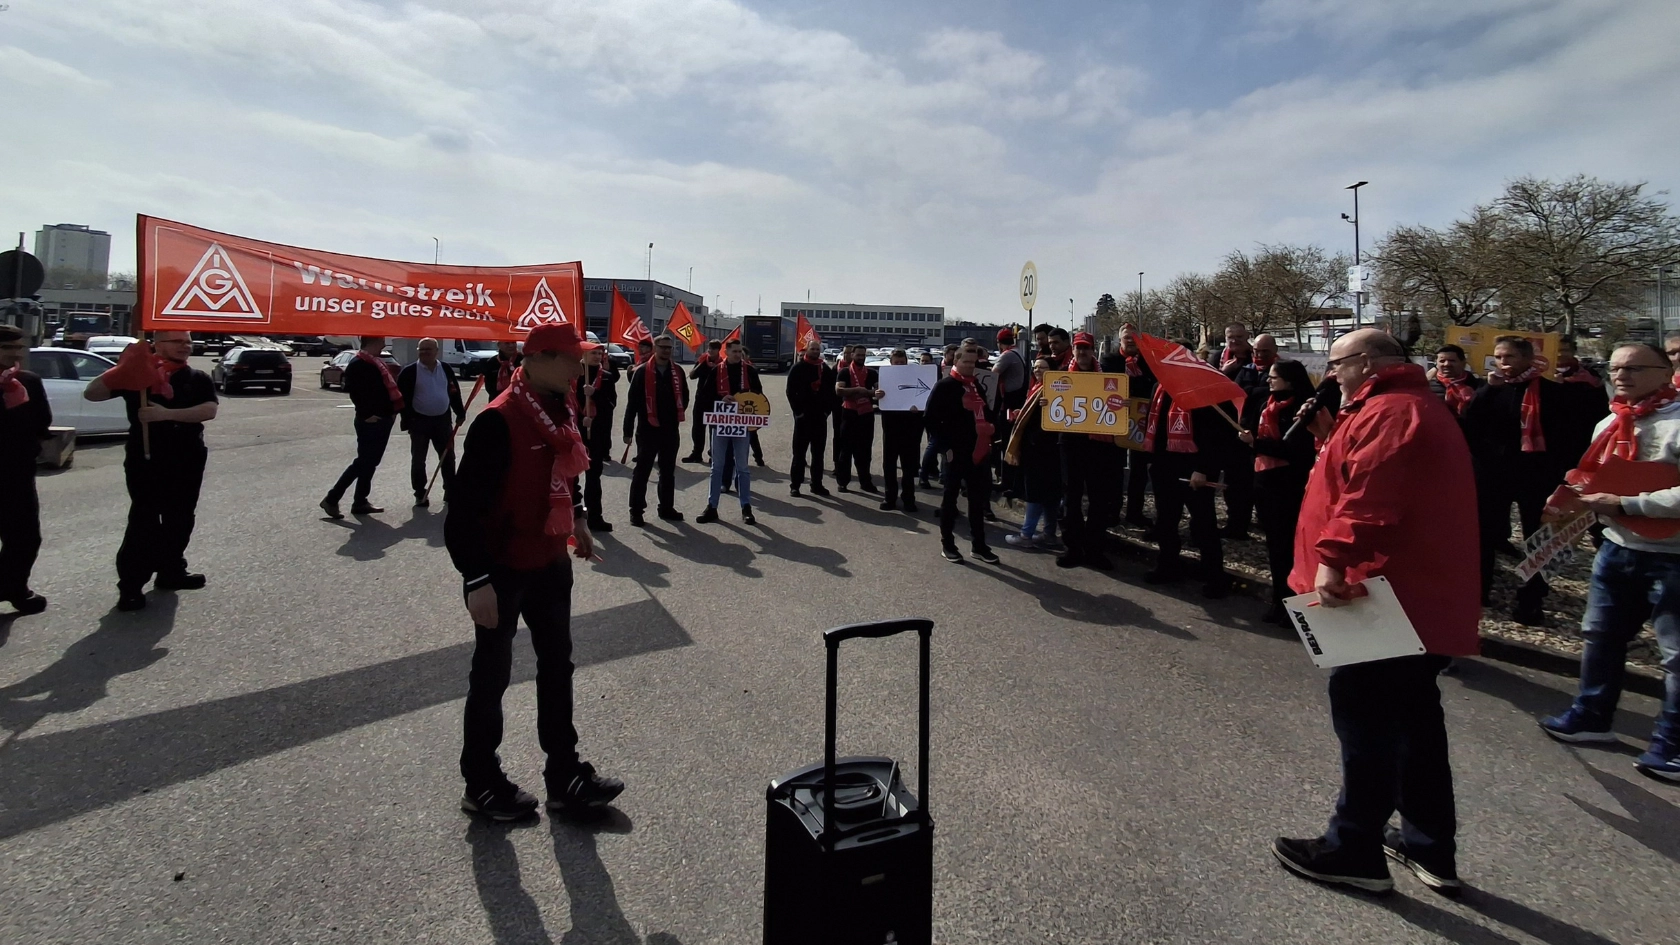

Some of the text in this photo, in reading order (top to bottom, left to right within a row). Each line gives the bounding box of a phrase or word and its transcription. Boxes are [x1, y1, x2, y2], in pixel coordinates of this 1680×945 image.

[1023, 275, 1034, 297] 20
[295, 296, 365, 313] unser
[371, 300, 433, 319] gutes
[715, 402, 736, 413] KFZ
[1050, 396, 1087, 428] 6,5
[705, 413, 769, 426] TARIFRUNDE
[718, 425, 745, 436] 2025
